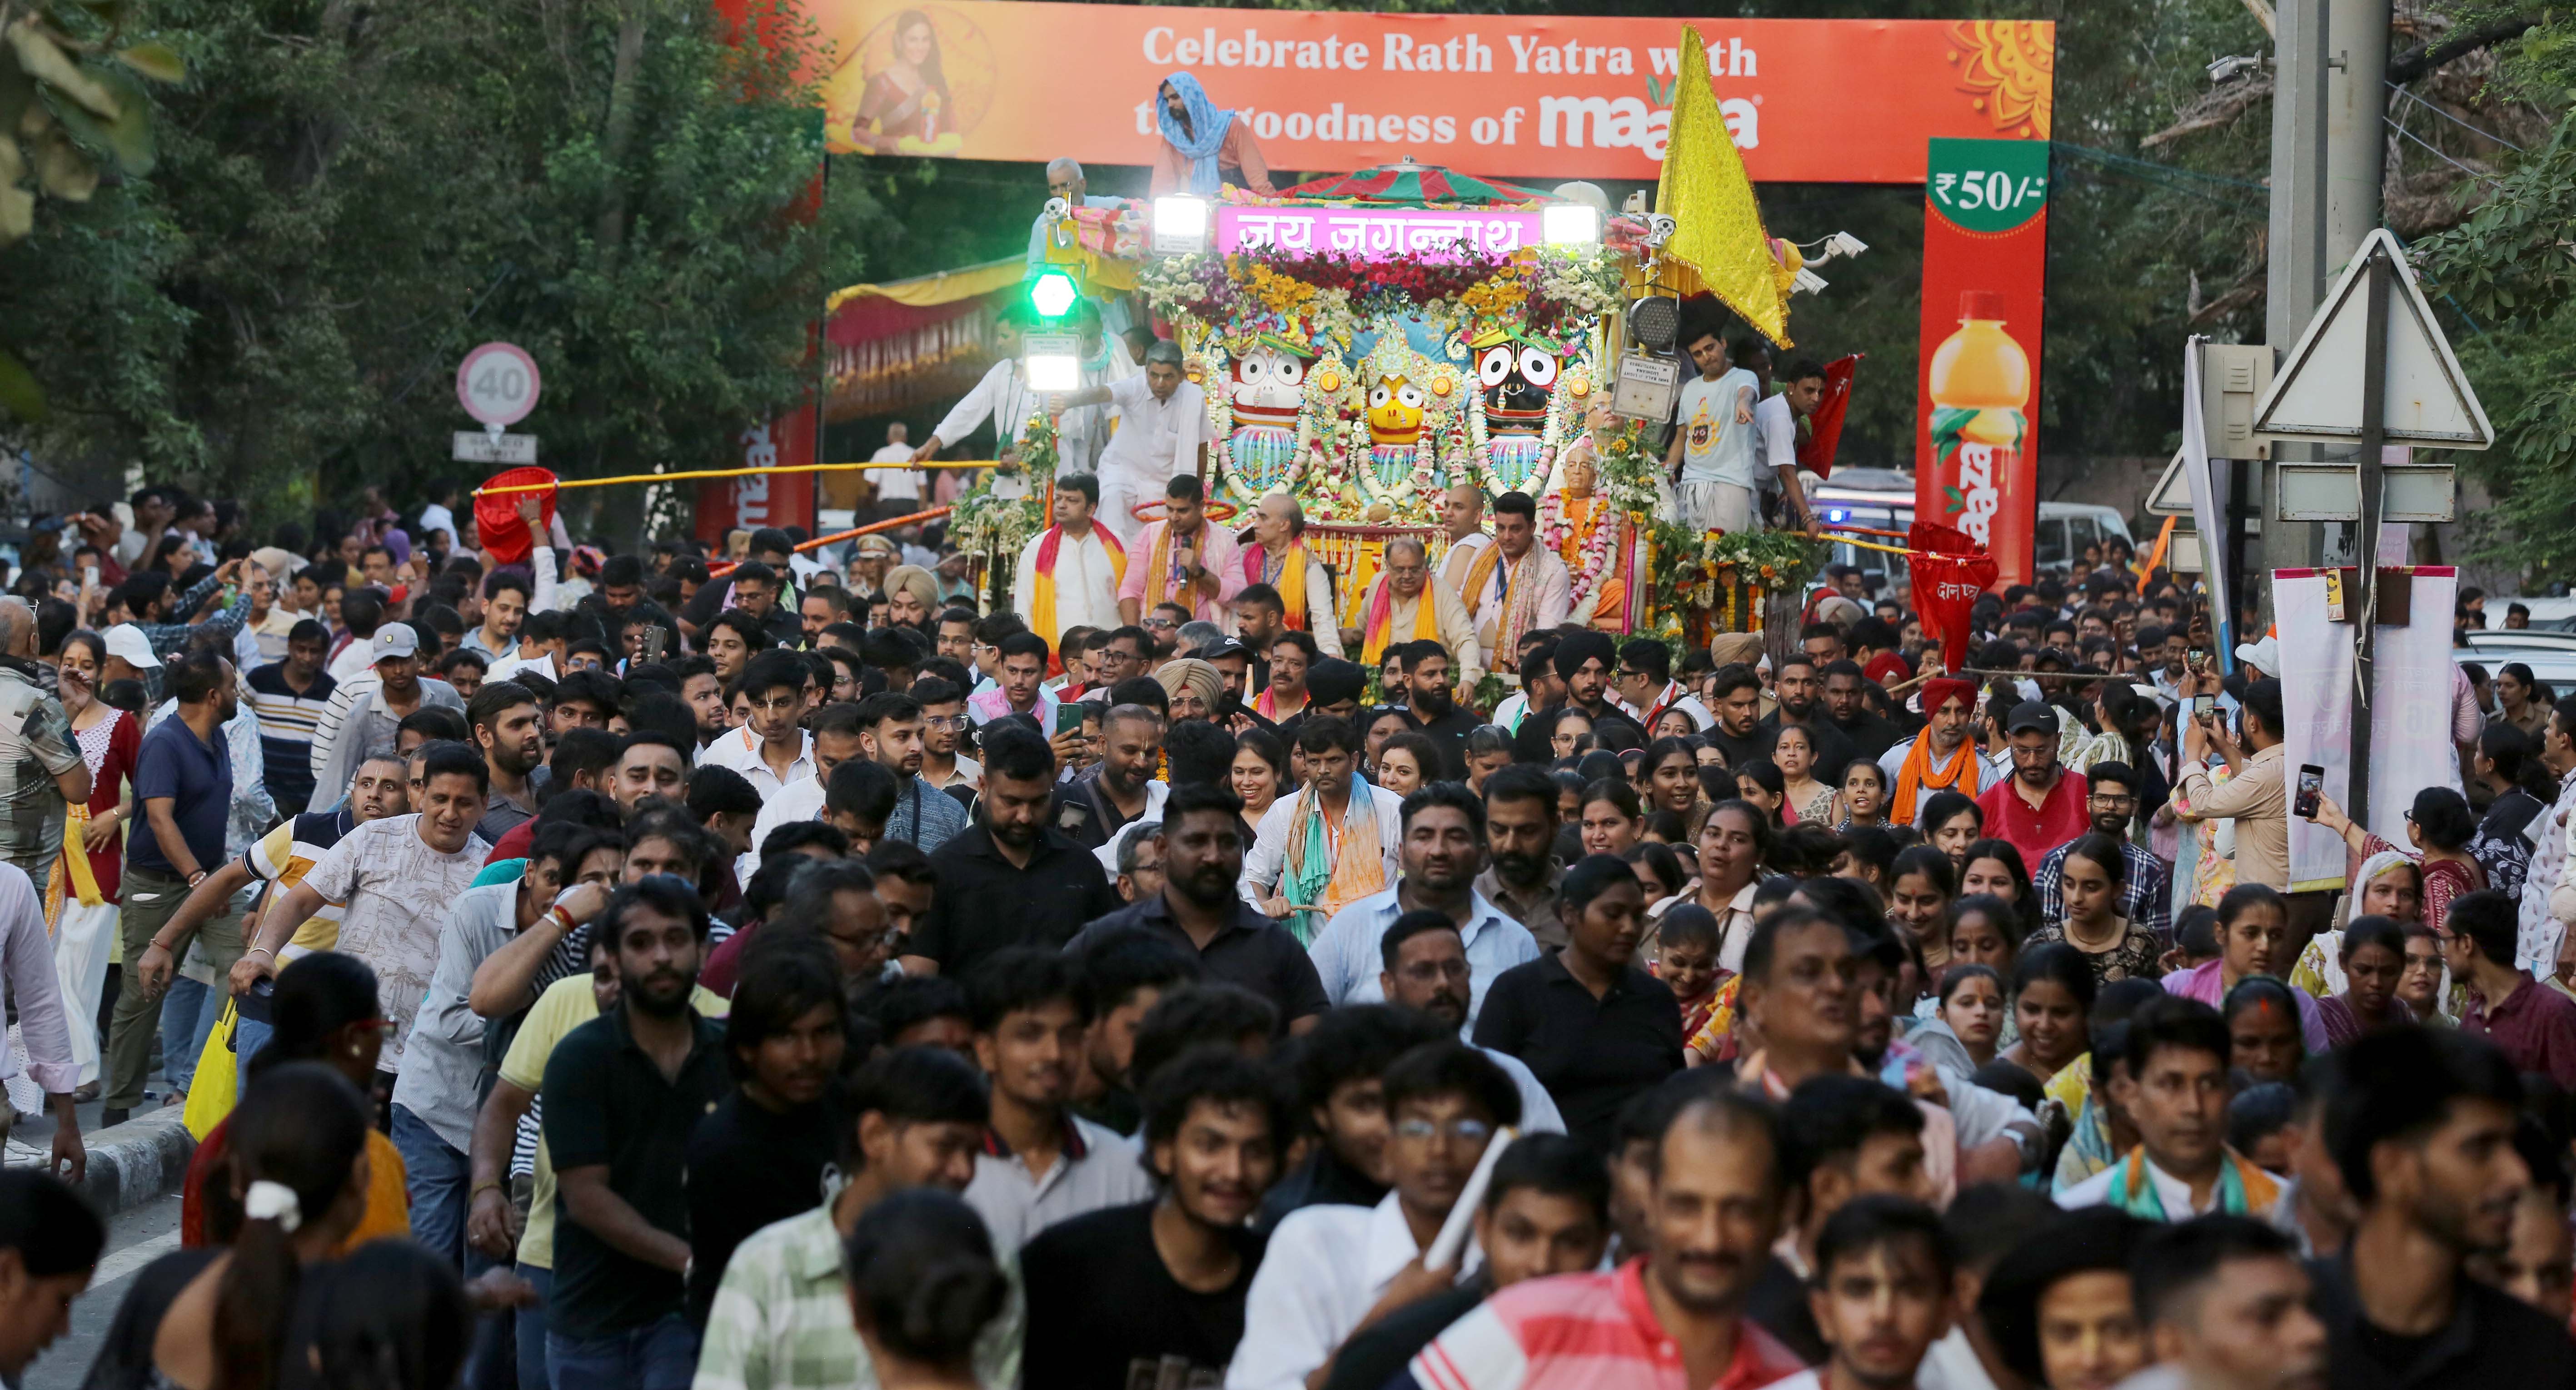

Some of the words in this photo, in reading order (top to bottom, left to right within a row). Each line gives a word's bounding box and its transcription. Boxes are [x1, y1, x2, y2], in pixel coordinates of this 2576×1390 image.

[1142, 26, 1370, 71] Celebrate
[1382, 33, 1493, 73] Rath
[1507, 35, 1634, 76] Yatra
[1647, 37, 1758, 77] wth
[1470, 106, 1525, 145] of
[1237, 214, 1316, 255] जय
[473, 366, 524, 402] 40
[1937, 581, 1959, 601] दान
